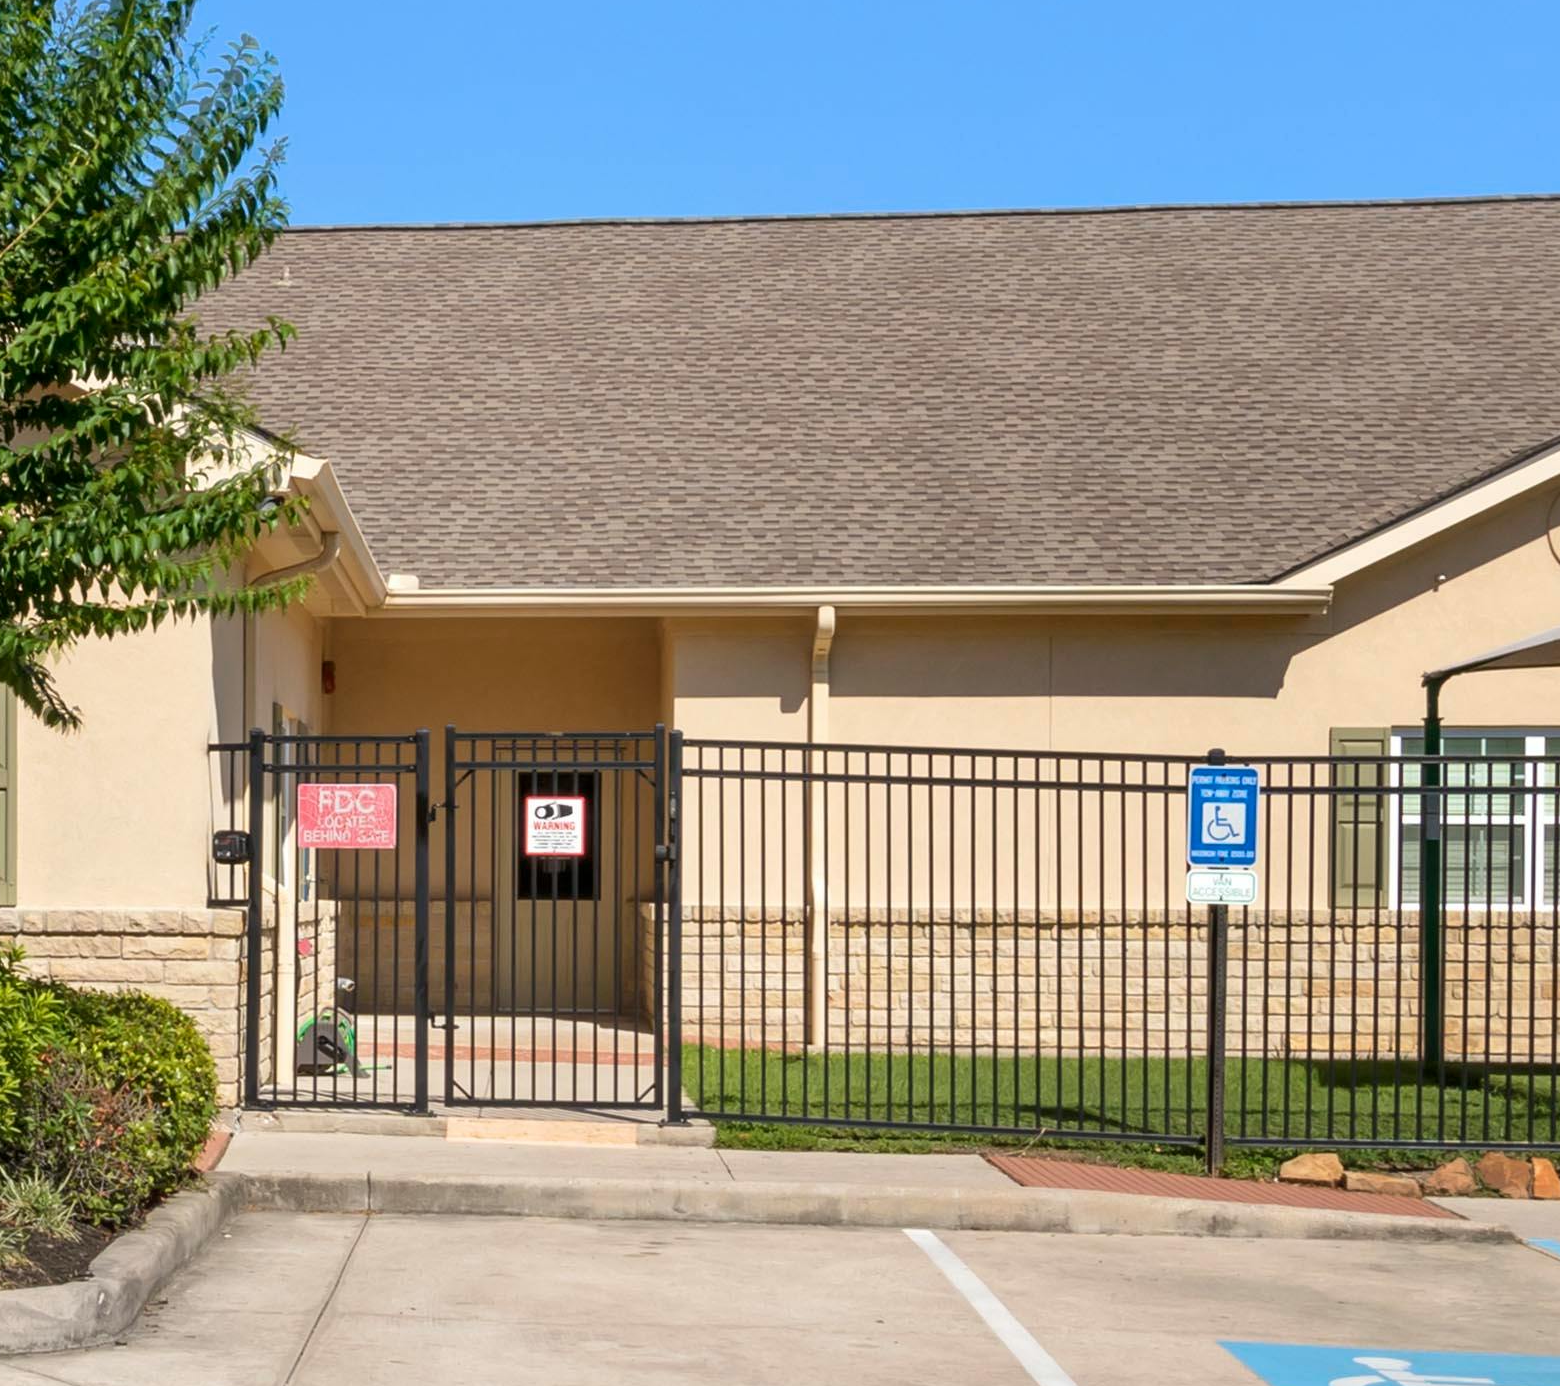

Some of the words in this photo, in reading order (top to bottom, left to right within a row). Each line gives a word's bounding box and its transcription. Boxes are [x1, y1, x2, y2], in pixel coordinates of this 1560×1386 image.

[318, 788, 376, 813] FDC
[533, 821, 576, 830] WARNING
[303, 829, 351, 843] BEHIND
[1213, 877, 1232, 886] VAN
[1192, 887, 1250, 898] ACCESSIBLE
